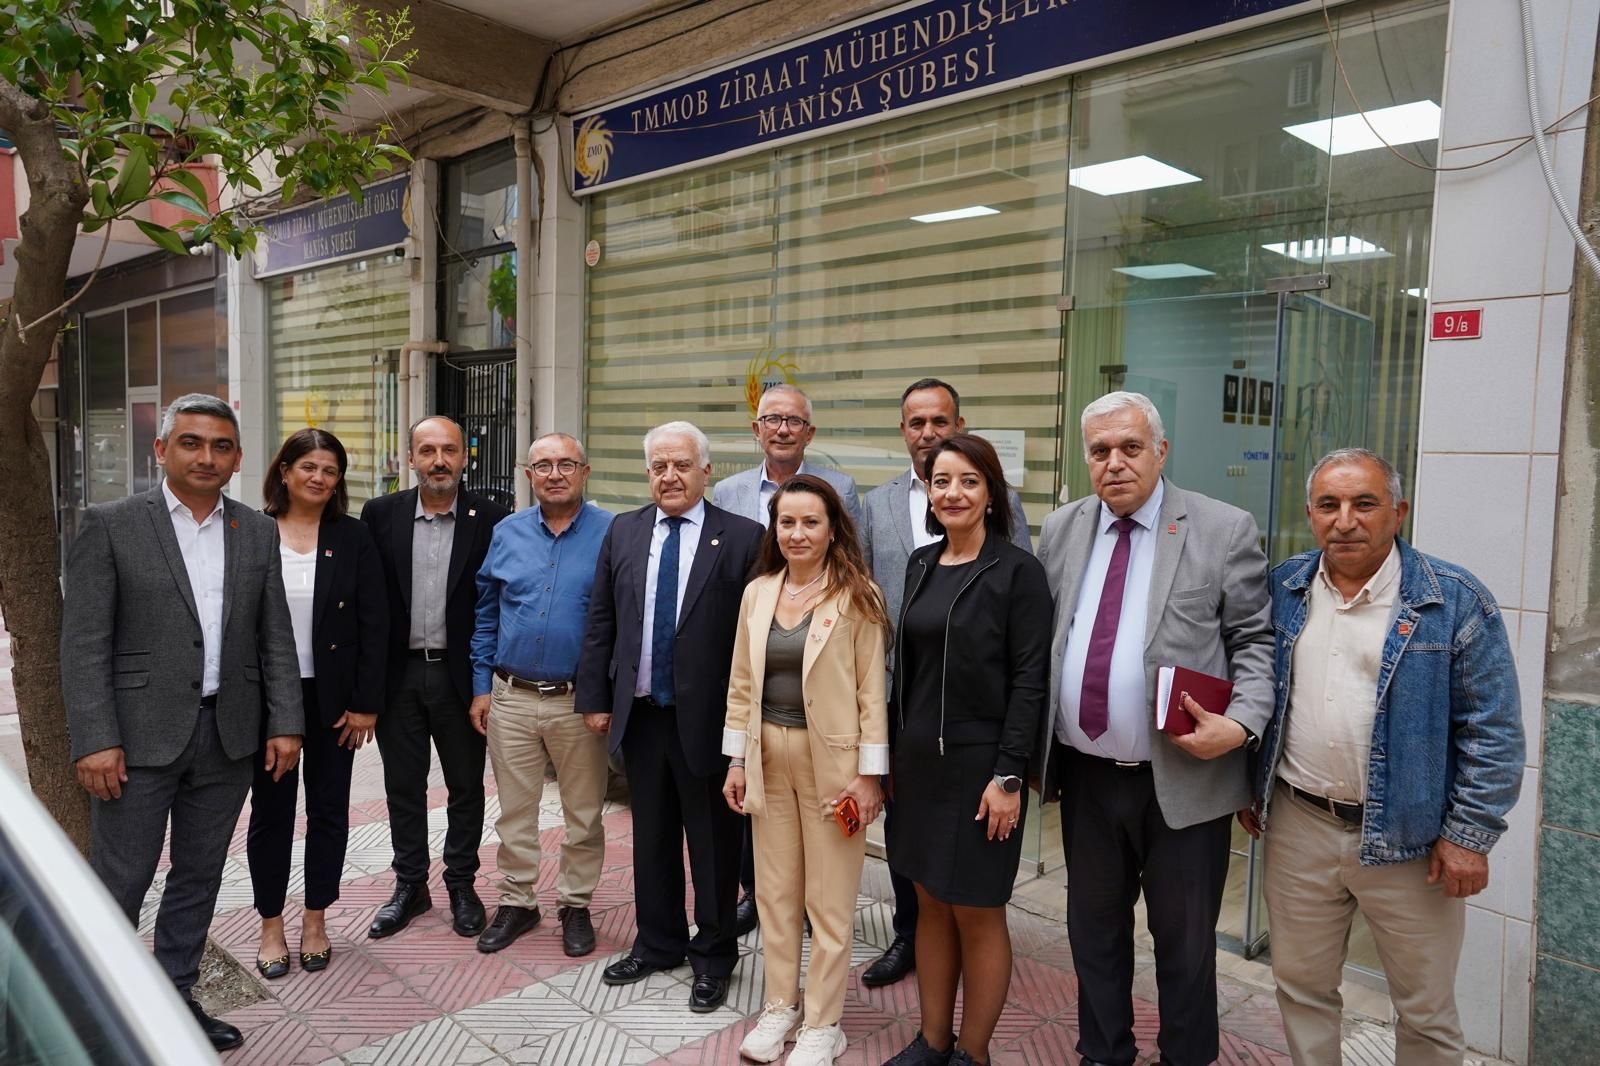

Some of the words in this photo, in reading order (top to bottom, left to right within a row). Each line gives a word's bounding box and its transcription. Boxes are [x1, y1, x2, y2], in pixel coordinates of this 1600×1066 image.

[631, 89, 709, 134] TMMOB
[719, 55, 809, 109] ZİRAAT
[758, 83, 865, 137] MANİSA
[879, 33, 996, 112] ŞUBESİ
[587, 143, 603, 158] ZMO
[374, 188, 399, 214] ODASI
[1444, 315, 1469, 333] 9/B
